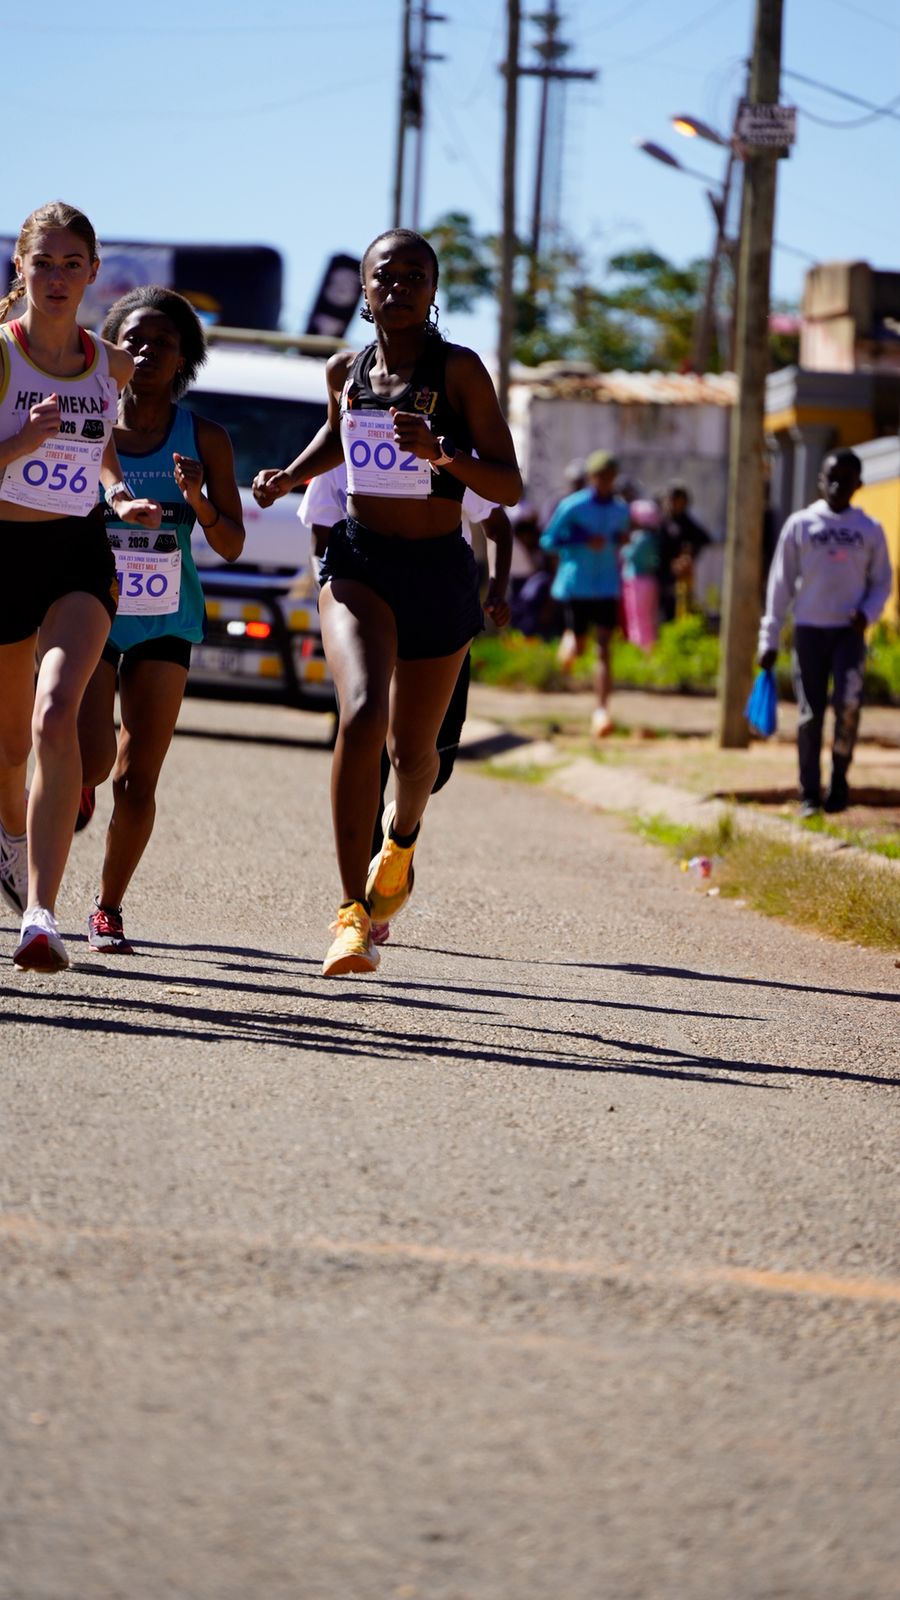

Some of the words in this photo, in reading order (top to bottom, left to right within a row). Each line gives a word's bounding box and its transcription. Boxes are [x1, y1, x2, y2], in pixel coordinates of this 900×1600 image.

[60, 421, 76, 434] 026
[85, 421, 103, 431] ASA
[367, 429, 385, 438] STREET
[386, 431, 394, 439] MIL
[45, 451, 63, 459] STREET
[63, 453, 76, 461] MILE
[350, 440, 419, 471] 002
[23, 460, 87, 493] 056
[128, 536, 149, 549] 2026
[810, 528, 864, 547] NASA
[127, 562, 145, 570] STREET
[146, 563, 157, 571] MILE
[117, 571, 168, 597] 130
